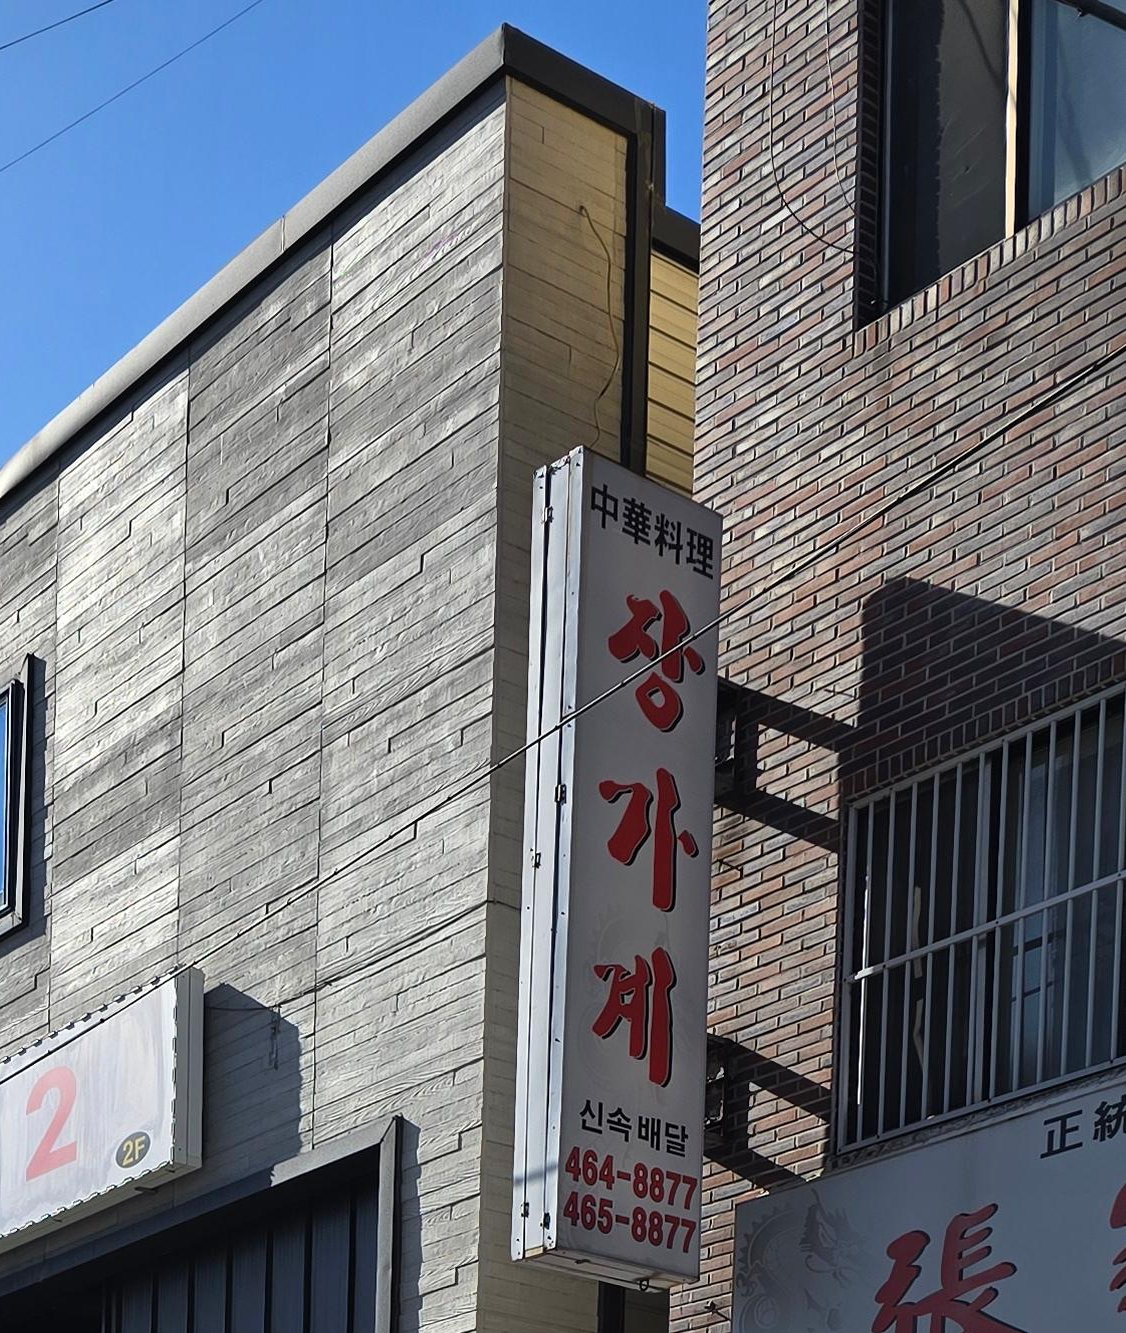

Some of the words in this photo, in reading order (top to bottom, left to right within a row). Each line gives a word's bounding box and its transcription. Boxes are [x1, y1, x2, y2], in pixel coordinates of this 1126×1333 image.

[590, 484, 713, 580] 中華料理
[591, 589, 706, 1087] 장가계
[121, 1132, 149, 1167] 2F
[565, 1146, 698, 1210] 464-8877
[563, 1191, 696, 1253] 465-8877
